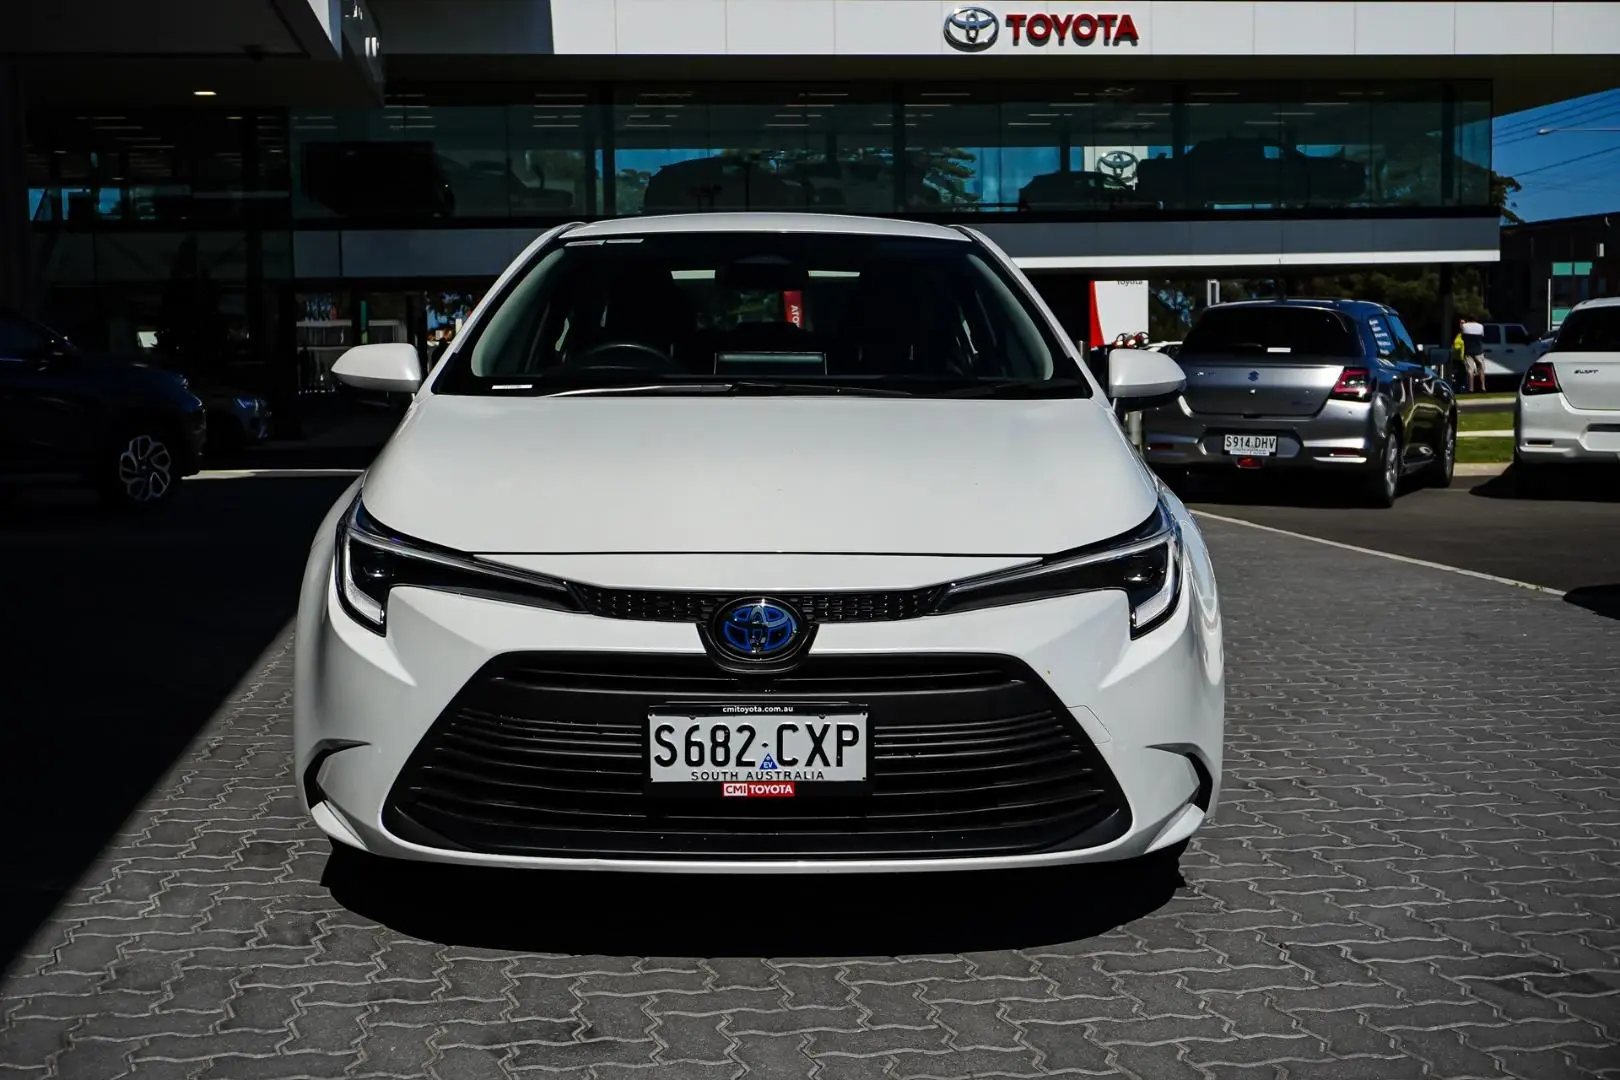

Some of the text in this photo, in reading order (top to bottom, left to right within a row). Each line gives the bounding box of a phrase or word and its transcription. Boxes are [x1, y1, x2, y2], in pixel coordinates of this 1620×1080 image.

[1006, 14, 1139, 43] TOYOTA
[722, 705, 794, 714] cmitoyota.com.au
[691, 771, 824, 781] SOUTH AUSTRALIA
[725, 784, 794, 795] CMI TOYOTA
